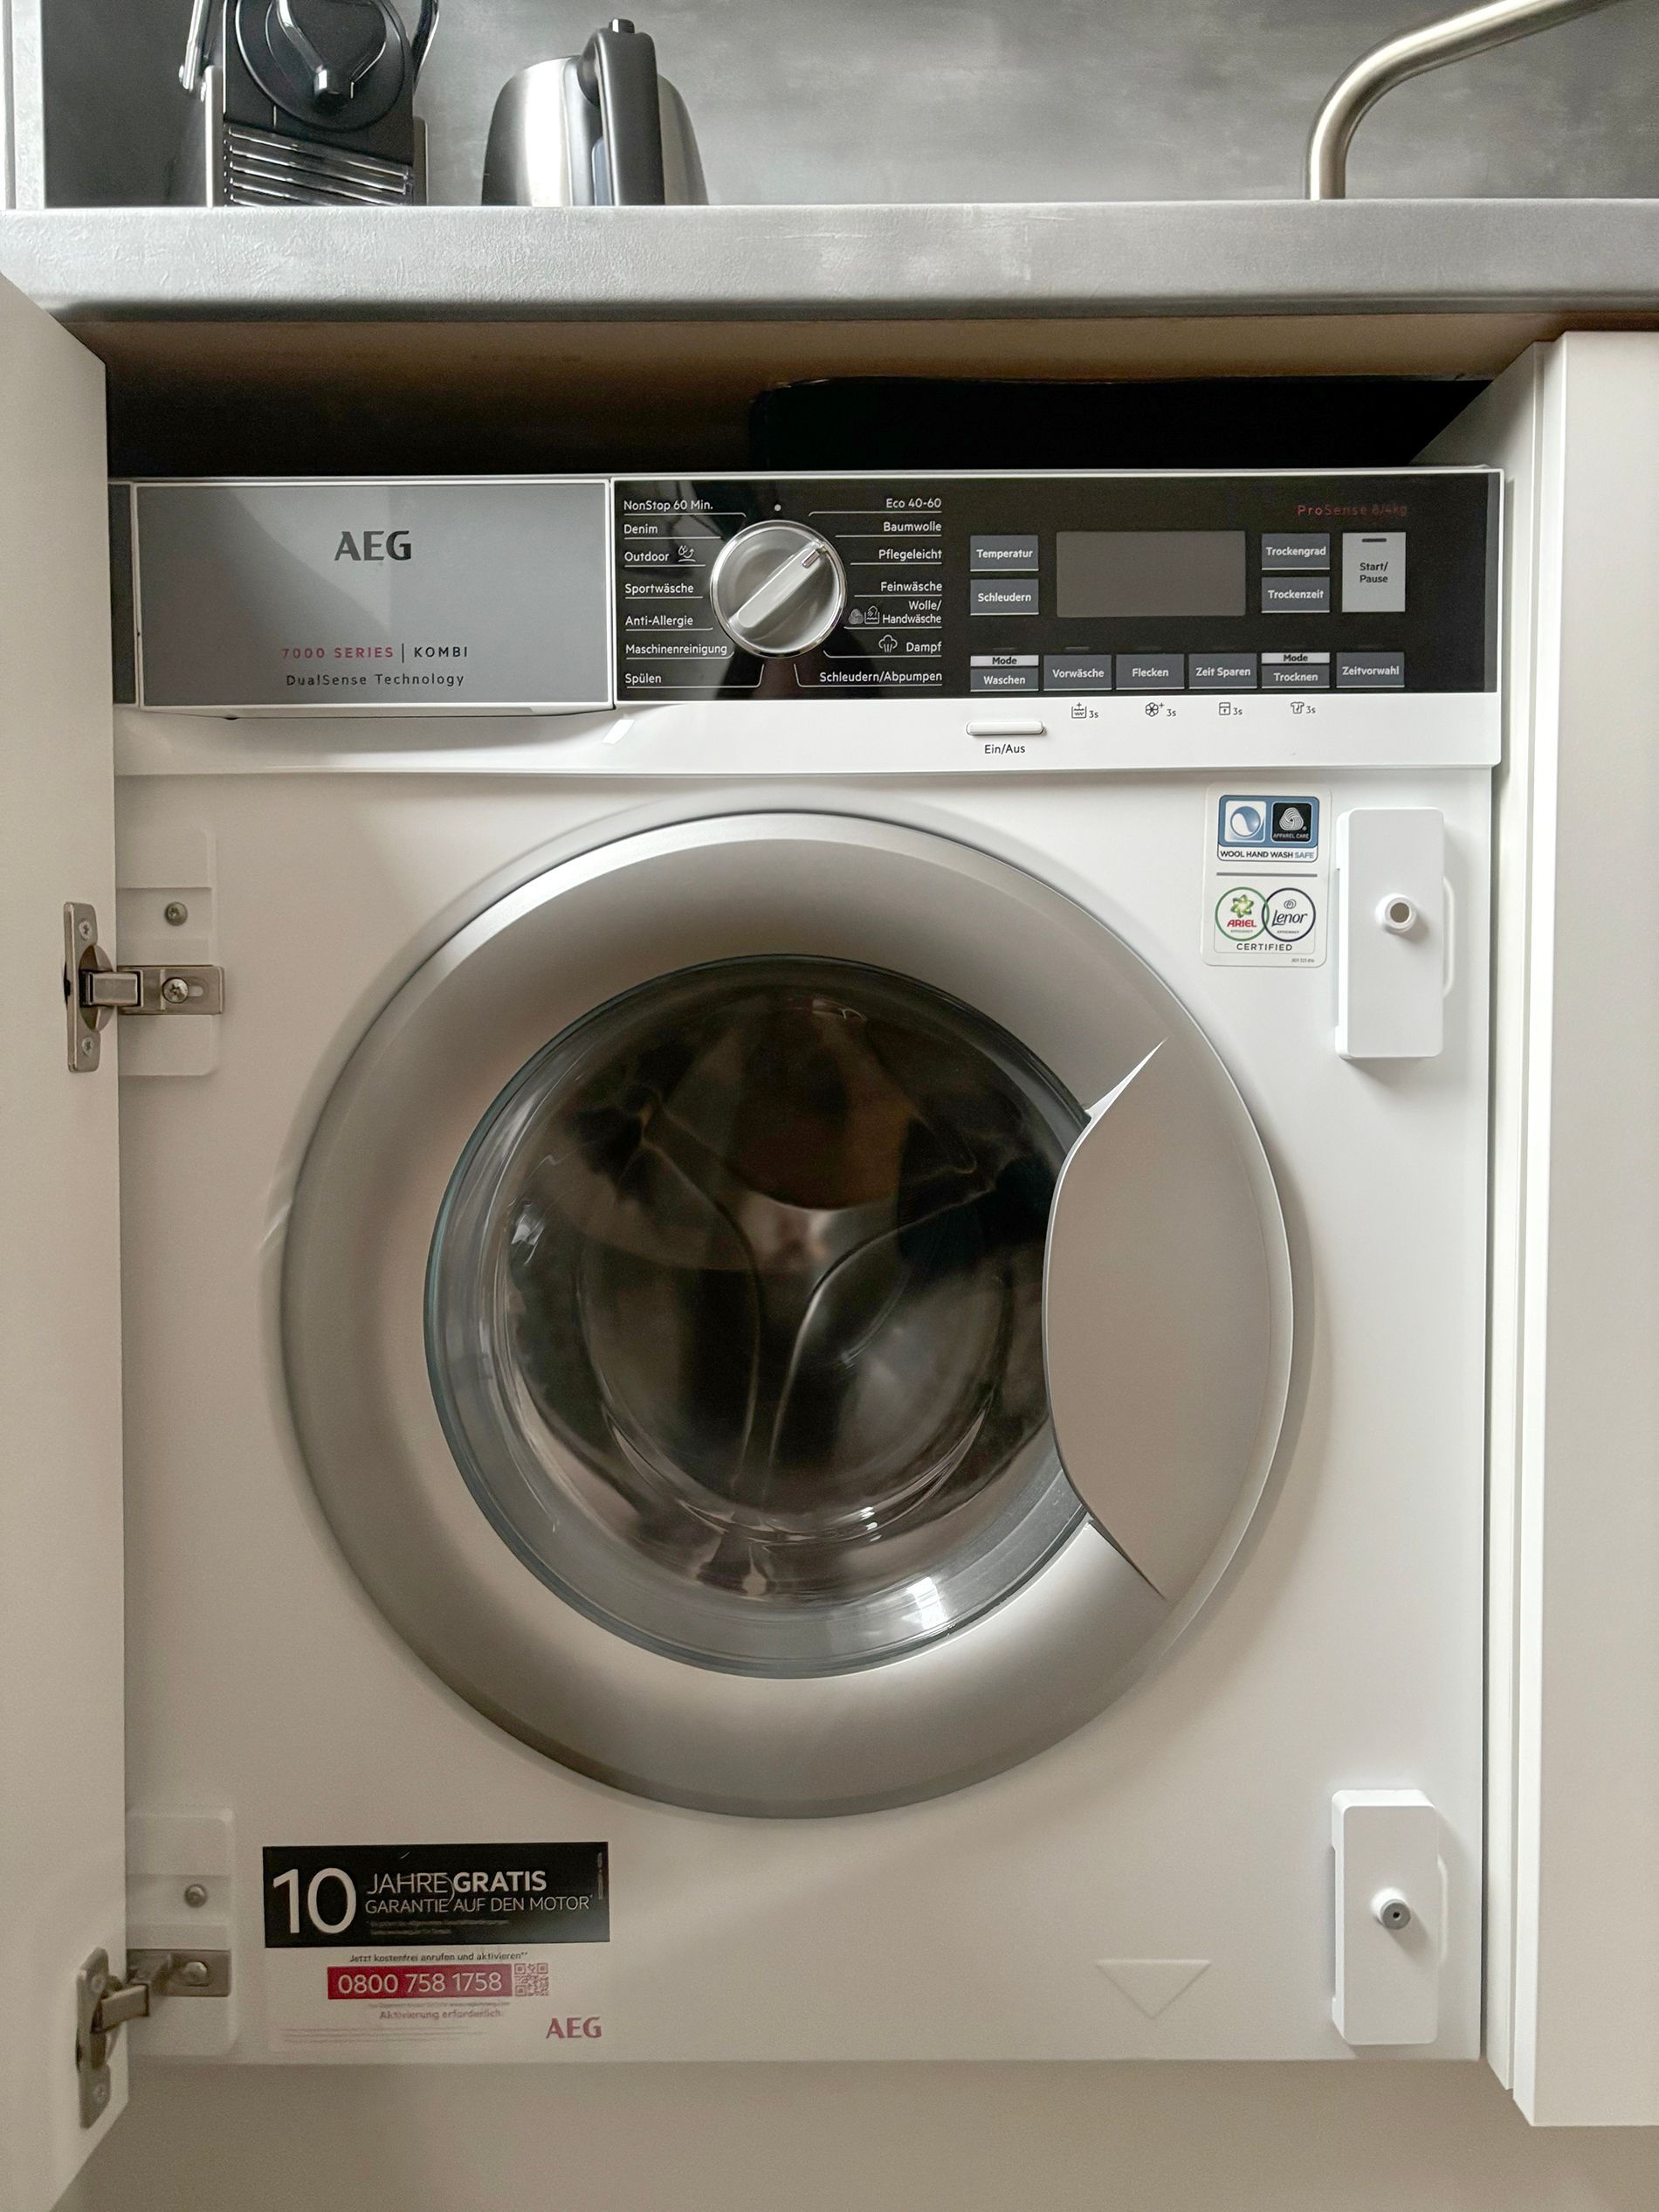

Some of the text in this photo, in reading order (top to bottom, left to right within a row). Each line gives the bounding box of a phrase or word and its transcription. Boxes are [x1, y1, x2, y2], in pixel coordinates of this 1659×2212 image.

[623, 500, 713, 511] NonStop 60 Min.
[886, 497, 942, 508] Eco 40-60
[1297, 505, 1367, 516] ProSense
[623, 523, 658, 534] Denim
[884, 521, 942, 532] Baumwolle
[334, 531, 412, 562] AEG
[624, 551, 670, 562] Outdoor
[878, 549, 943, 561] Pflegeleicht
[976, 549, 1033, 559] Temperatur
[1266, 547, 1326, 558] Trockengrad
[1360, 562, 1388, 572] Start/
[1360, 575, 1388, 583] Pause
[624, 582, 694, 595] Sportwäsche
[880, 581, 943, 592] Feinwäsche
[977, 592, 1032, 603] Schleudern
[1268, 589, 1324, 599] Trockenzeit
[908, 600, 942, 611] Wolle/
[624, 615, 694, 628] Anti-Allergie
[882, 614, 942, 624] Handwäsche
[625, 643, 727, 656] Maschinenreinigung
[905, 640, 942, 653] Dampf
[281, 646, 468, 659] 7000 SERIES KOMBI
[1283, 653, 1308, 663] Mode
[992, 656, 1017, 665] Mode
[1052, 667, 1105, 679] Vorwäsche
[1132, 667, 1169, 677] Flecken
[1195, 666, 1251, 679] Zeit Sparen
[1342, 665, 1400, 676] Zeitvorwahl
[286, 673, 465, 687] DualSense Technology
[624, 672, 662, 686] Spülen
[819, 671, 943, 685] Schleudern/Abpumpen
[983, 675, 1026, 685] Waschen
[1273, 672, 1318, 681] Trocknen
[1089, 710, 1099, 719] 3s
[1167, 708, 1177, 717] 3s
[1232, 707, 1243, 716] 3s
[1305, 706, 1317, 714] 3s
[984, 743, 1026, 755] Ein/Aus
[1270, 851, 1293, 859] WASH
[1271, 909, 1308, 927] Lenor
[1236, 942, 1293, 952] CERTIFIED
[367, 1870, 547, 1896] JAHRE GRATIS
[272, 1866, 357, 1935] 10
[365, 1898, 449, 1914] GARANTIE
[453, 1898, 486, 1912] AUF
[490, 1897, 525, 1912] DEN
[349, 1954, 372, 1963] Jetzt
[374, 1953, 419, 1962] kostenfrei
[420, 1953, 456, 1962] anrufen
[457, 1952, 474, 1961] und
[337, 1971, 503, 1995] 0800 758 1758
[546, 2016, 602, 2040] AEG
